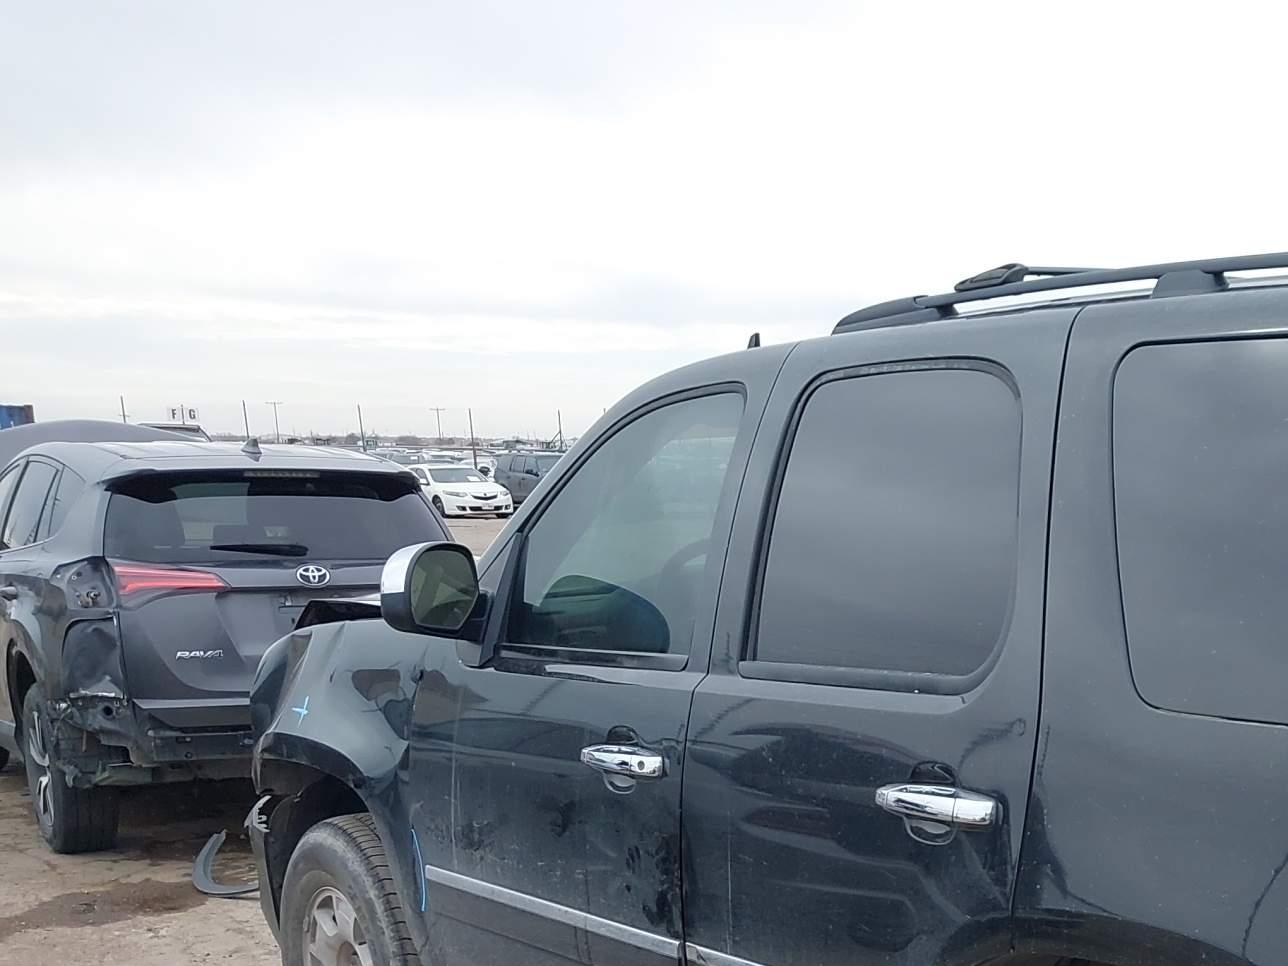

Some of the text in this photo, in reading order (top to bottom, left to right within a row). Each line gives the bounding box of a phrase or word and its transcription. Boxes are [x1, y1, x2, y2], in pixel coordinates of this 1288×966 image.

[171, 408, 177, 420] F
[189, 408, 196, 420] G
[175, 649, 224, 660] RAV4
